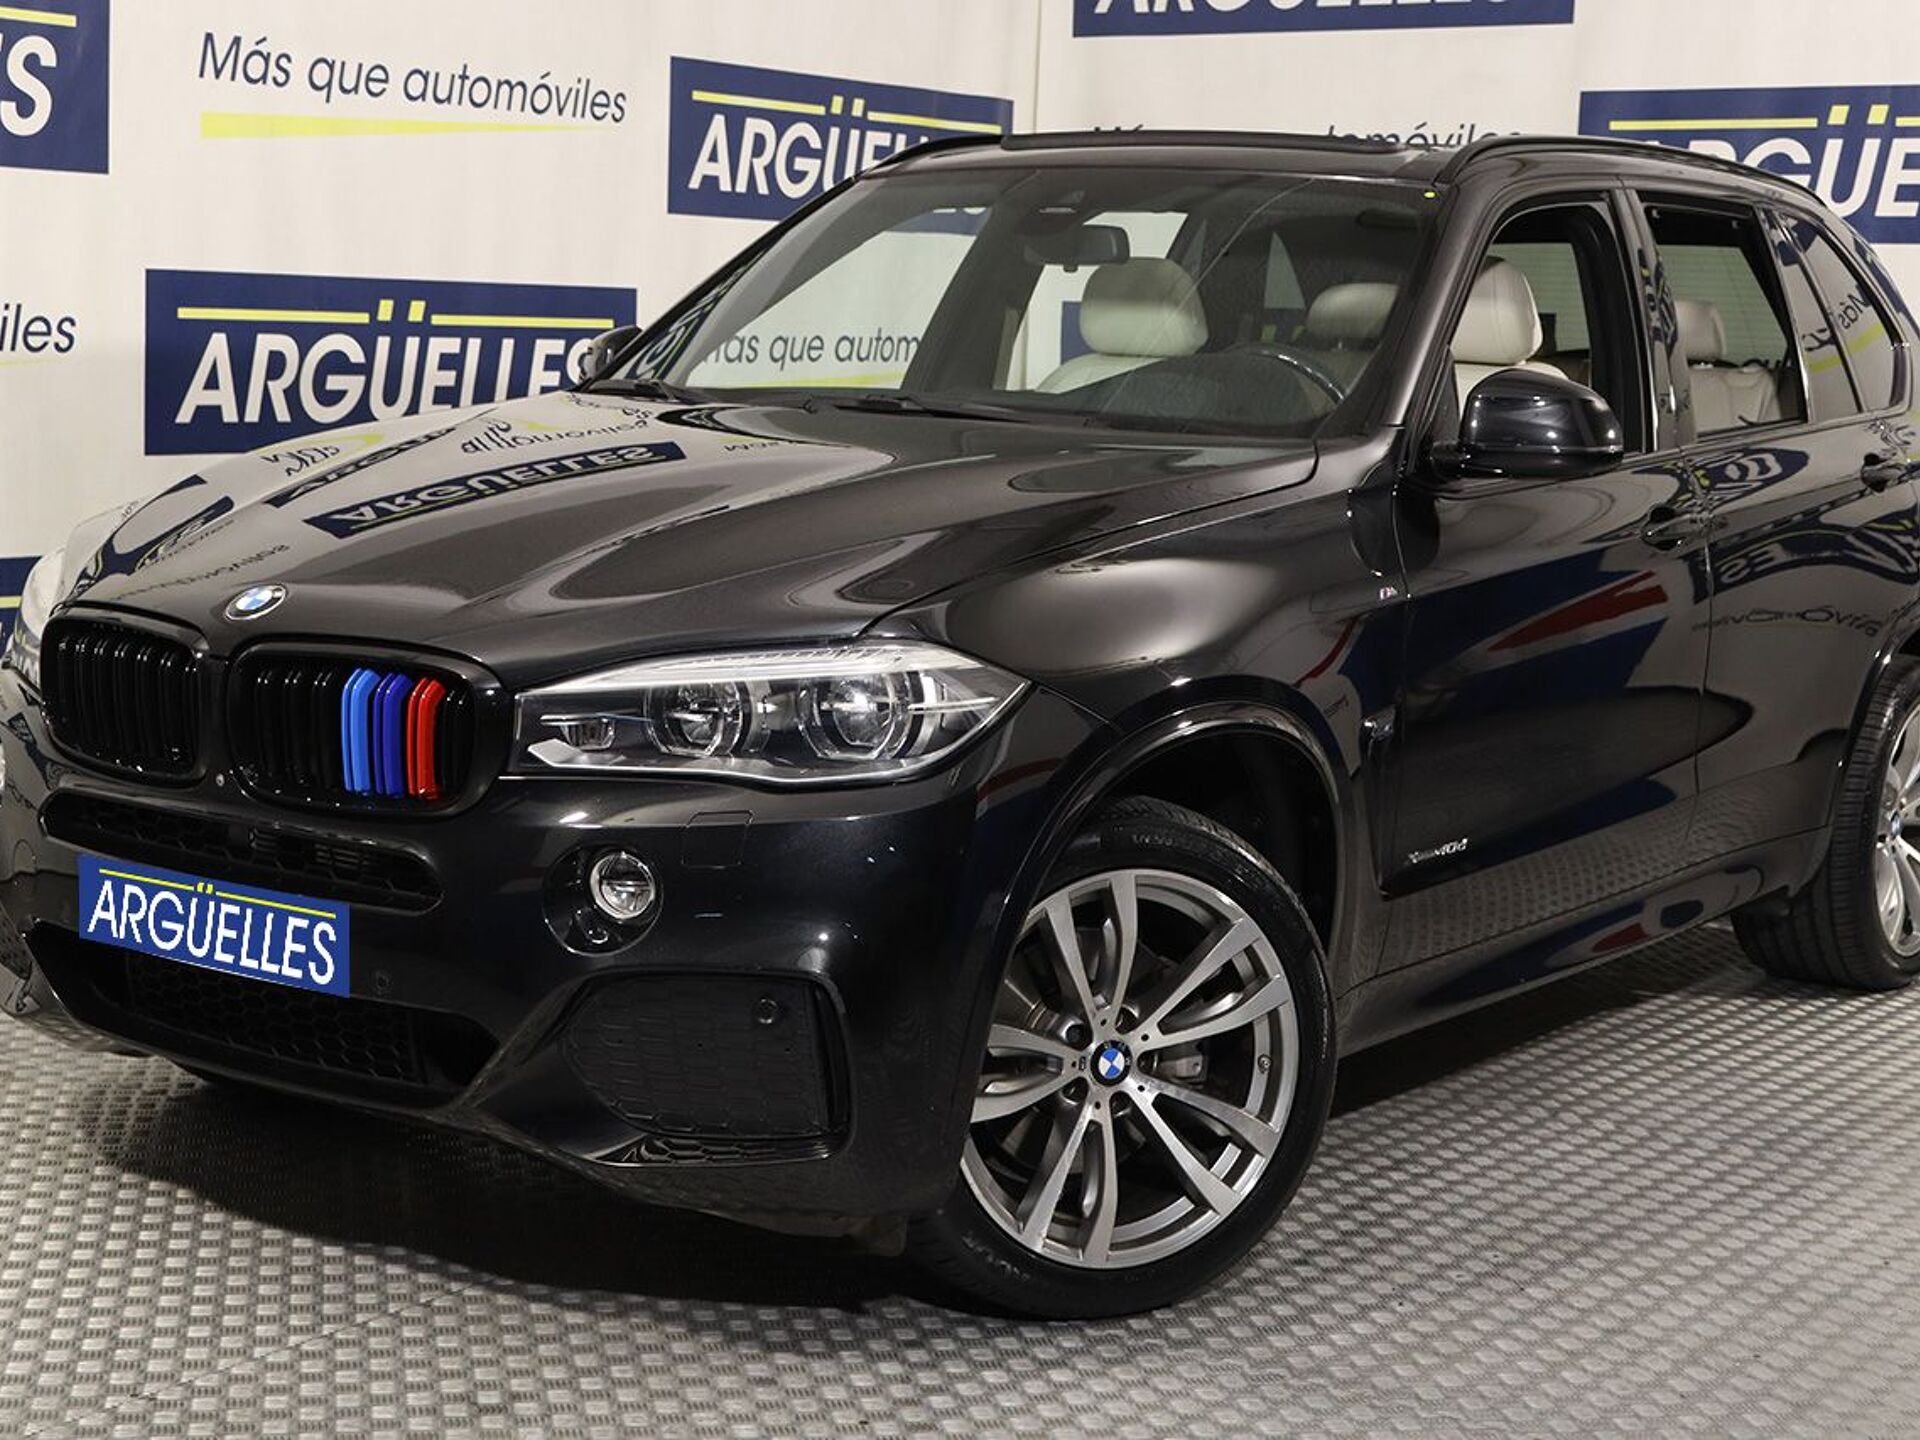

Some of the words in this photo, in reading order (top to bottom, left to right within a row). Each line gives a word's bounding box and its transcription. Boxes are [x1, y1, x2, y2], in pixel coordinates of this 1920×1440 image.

[198, 31, 292, 88] Más
[308, 56, 390, 104] que
[403, 63, 627, 123] automóviles
[0, 303, 76, 353] iles
[769, 334, 825, 371] que
